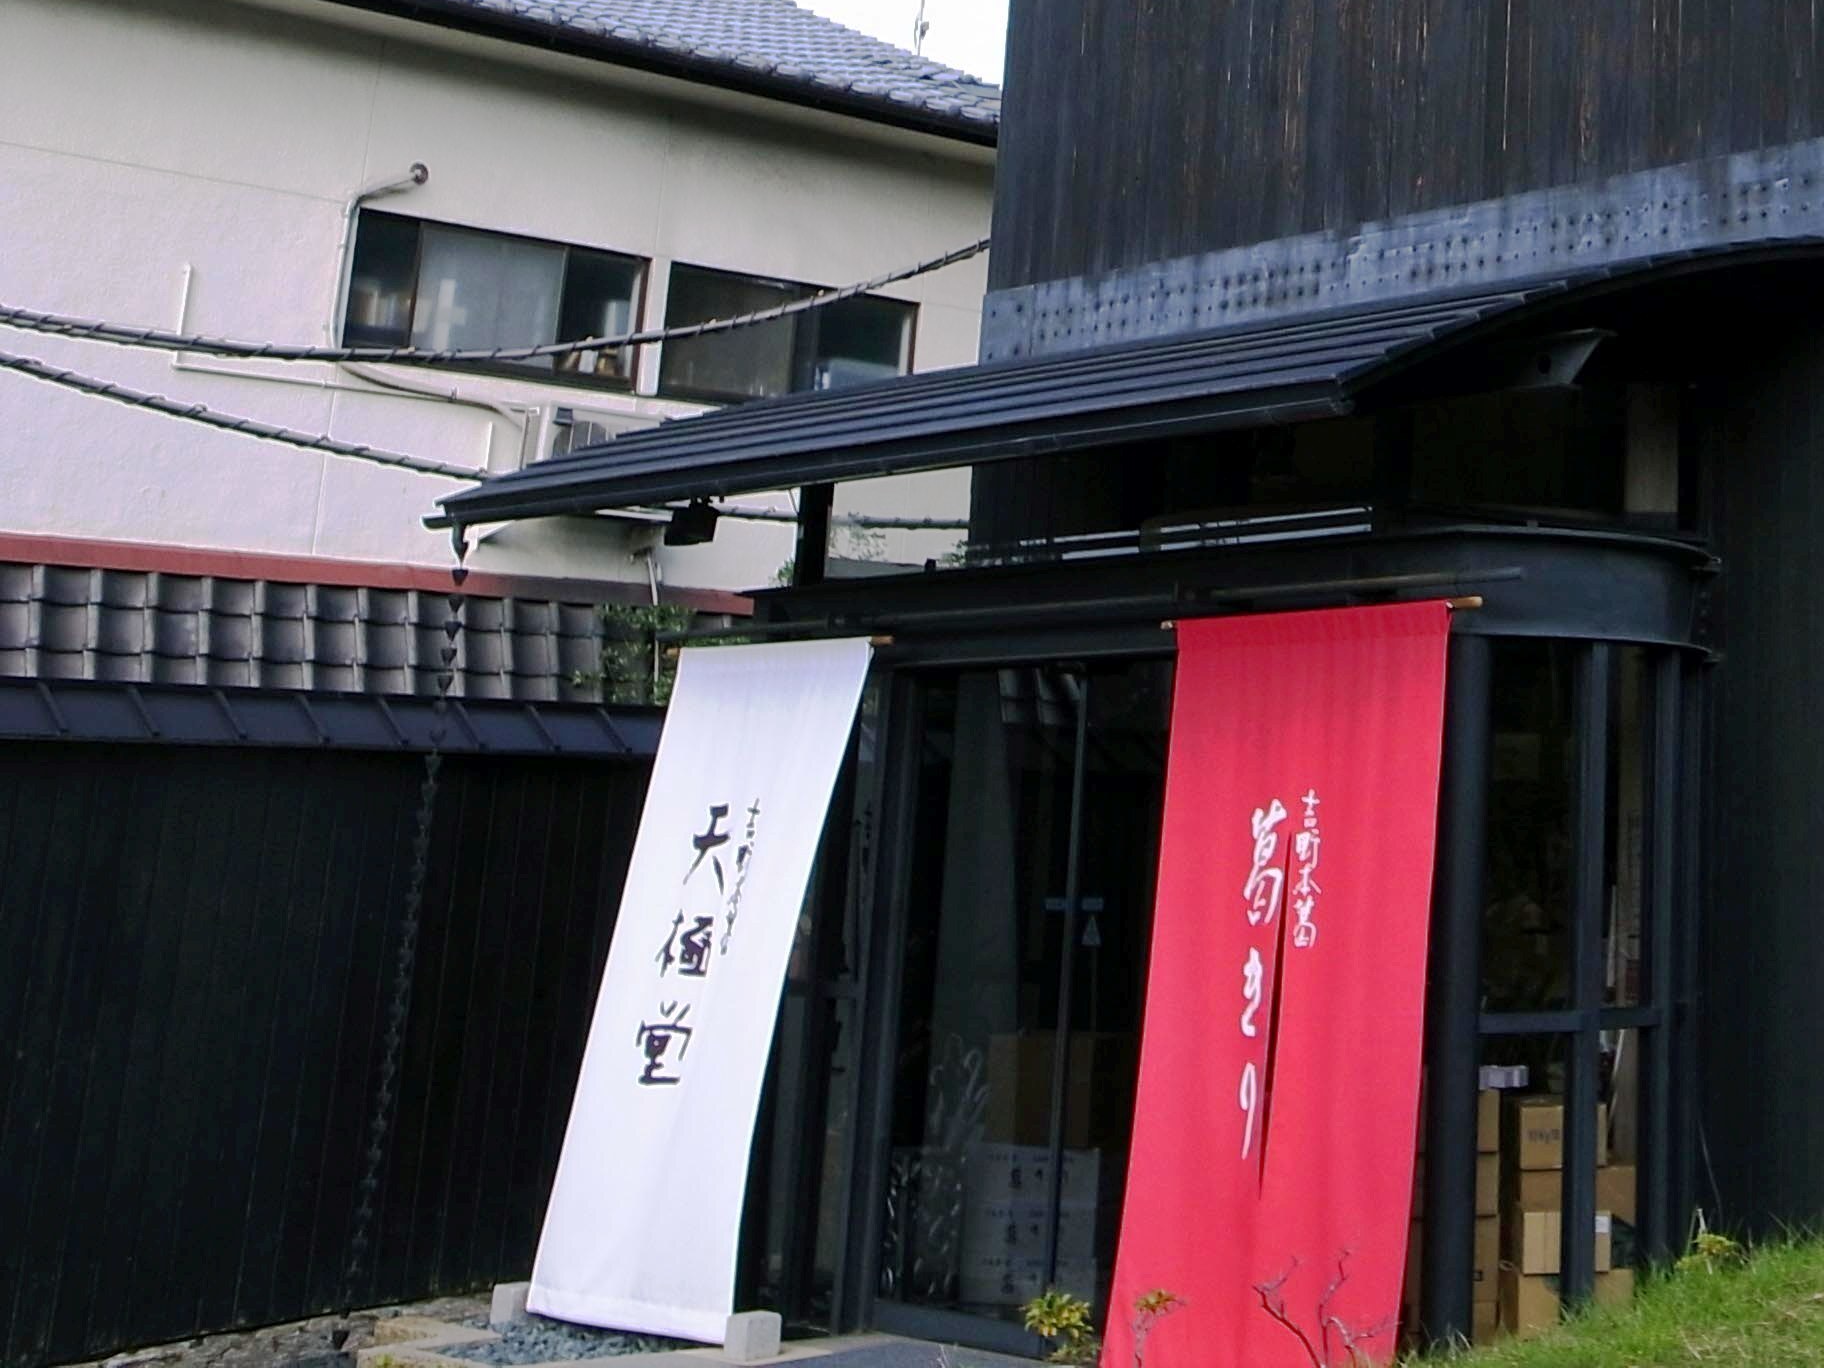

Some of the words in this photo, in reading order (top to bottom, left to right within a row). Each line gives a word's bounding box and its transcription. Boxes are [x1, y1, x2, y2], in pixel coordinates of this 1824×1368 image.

[636, 803, 730, 1085] 天極堂
[1240, 798, 1287, 1160] 葛きり
[1292, 788, 1322, 948] 吉野本葛
